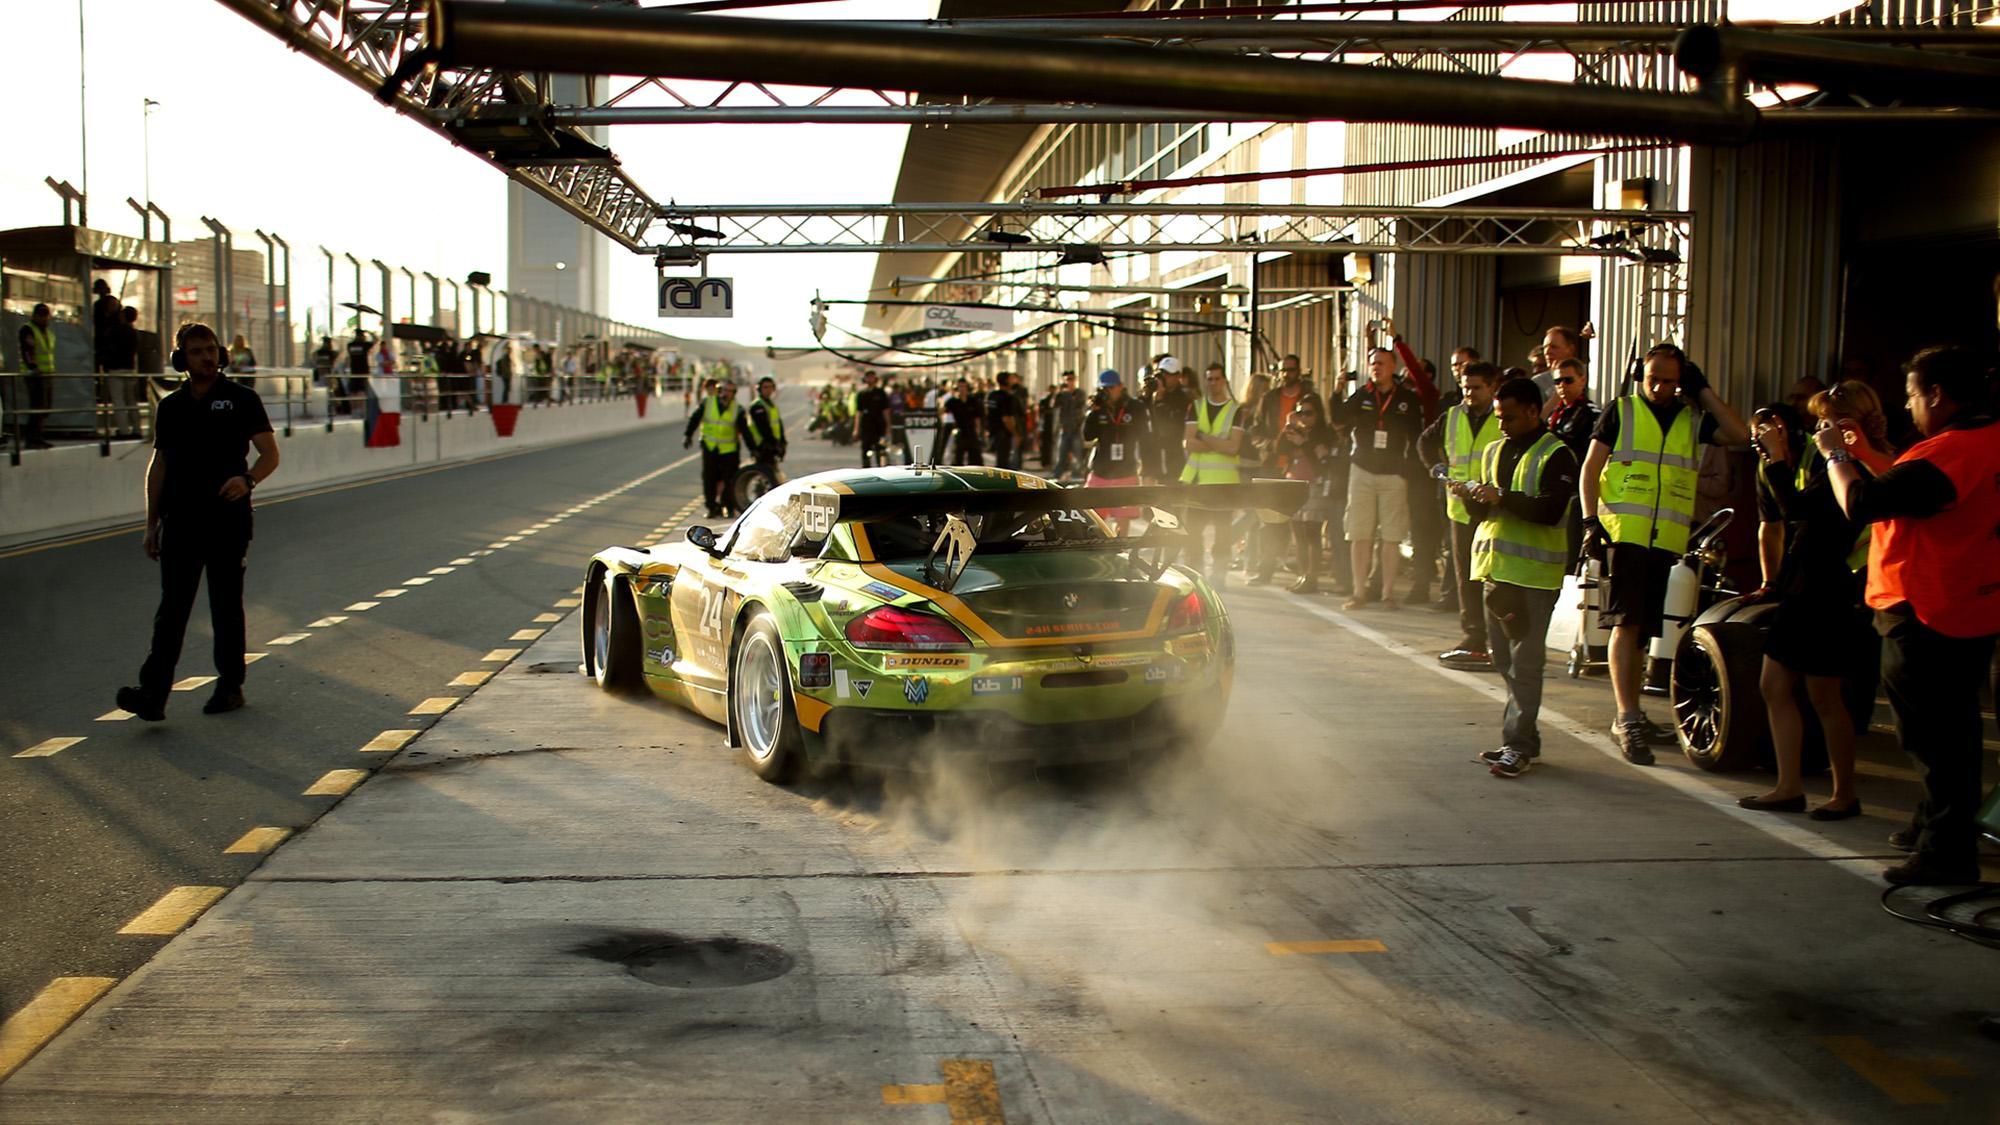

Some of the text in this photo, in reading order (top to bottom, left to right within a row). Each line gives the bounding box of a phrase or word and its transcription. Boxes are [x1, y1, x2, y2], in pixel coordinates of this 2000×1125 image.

[660, 278, 732, 309] ram
[926, 306, 960, 320] GDL
[905, 416, 938, 427] STOP
[1052, 509, 1087, 523] 24
[700, 587, 722, 640] 24
[900, 653, 966, 666] DUNLOP
